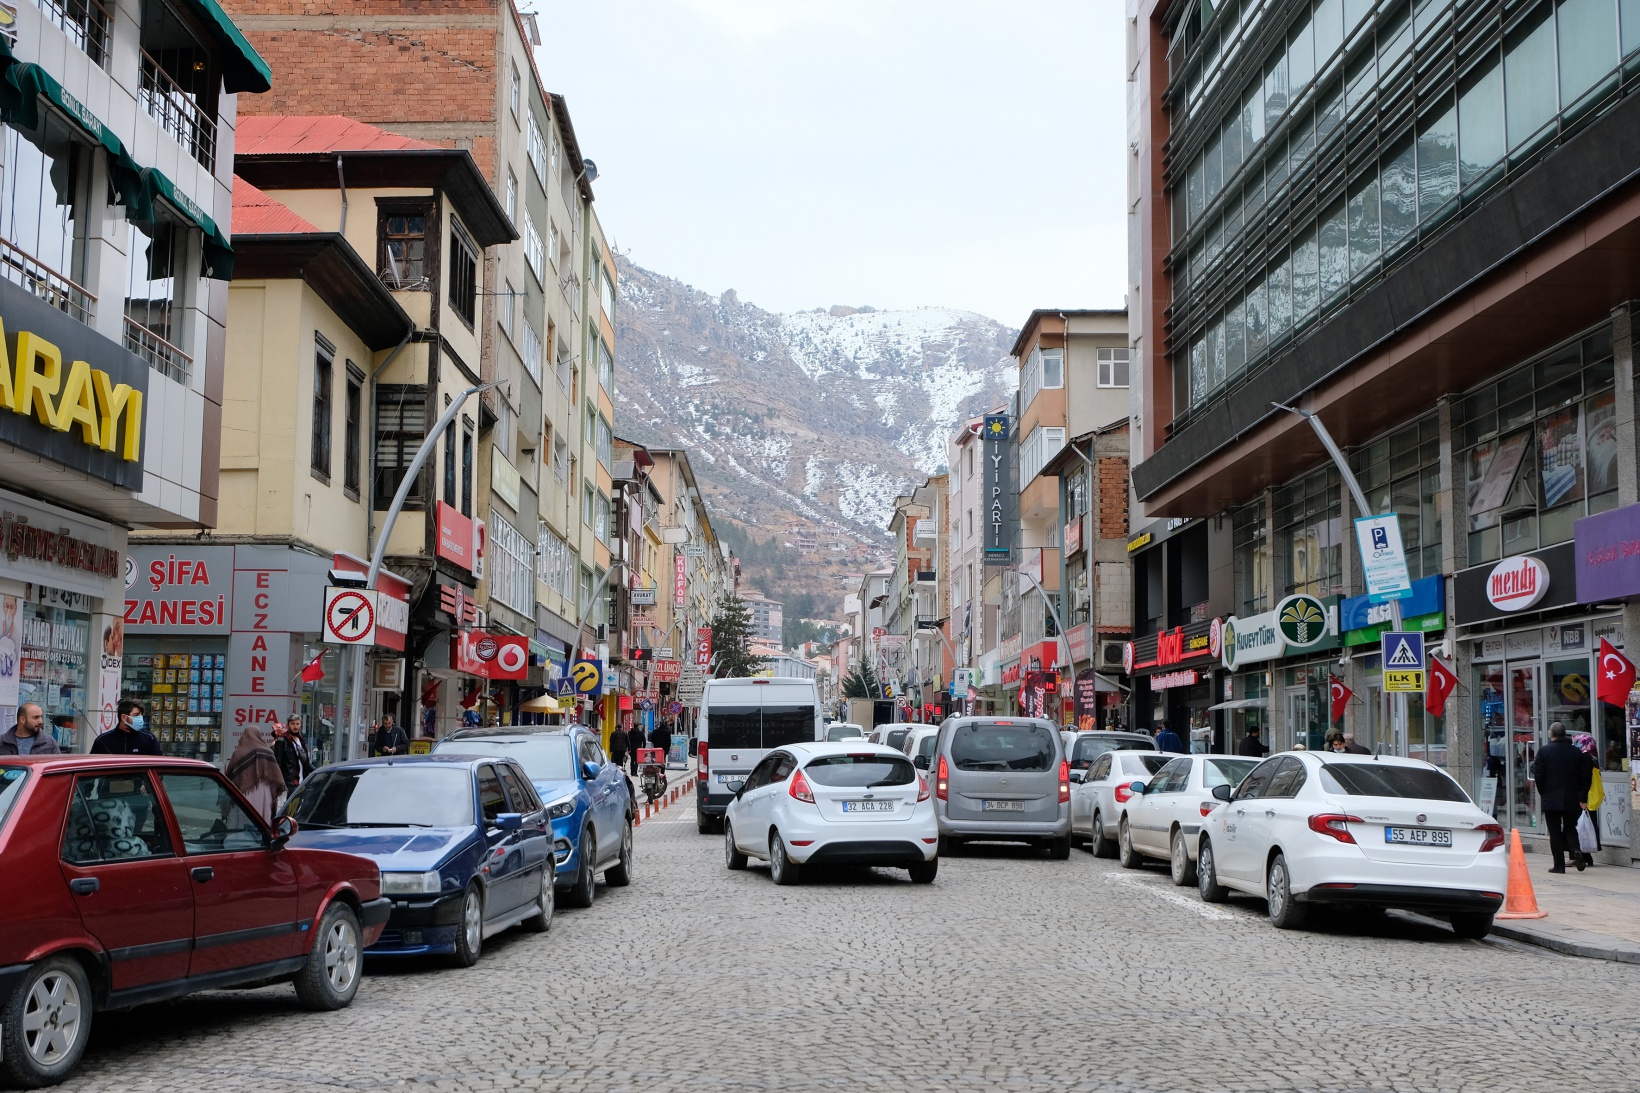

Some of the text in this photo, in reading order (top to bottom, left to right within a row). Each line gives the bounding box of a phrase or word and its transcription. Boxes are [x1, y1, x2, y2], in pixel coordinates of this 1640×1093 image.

[991, 487, 1002, 546] PARTİ
[149, 554, 210, 592] ŞİFA
[677, 559, 685, 604] KUAFÖR
[1492, 559, 1537, 597] mendy
[123, 594, 225, 626] ZANESİ
[251, 572, 270, 693] ECZANE
[1563, 630, 1580, 644] NBB
[1389, 674, 1410, 682] İLK
[234, 704, 279, 727] ŞİFA
[847, 802, 857, 811] 32
[861, 802, 875, 811] ACA
[879, 801, 893, 811] 228
[986, 801, 994, 809] 34
[1392, 829, 1449, 844] 55 AEP 895
